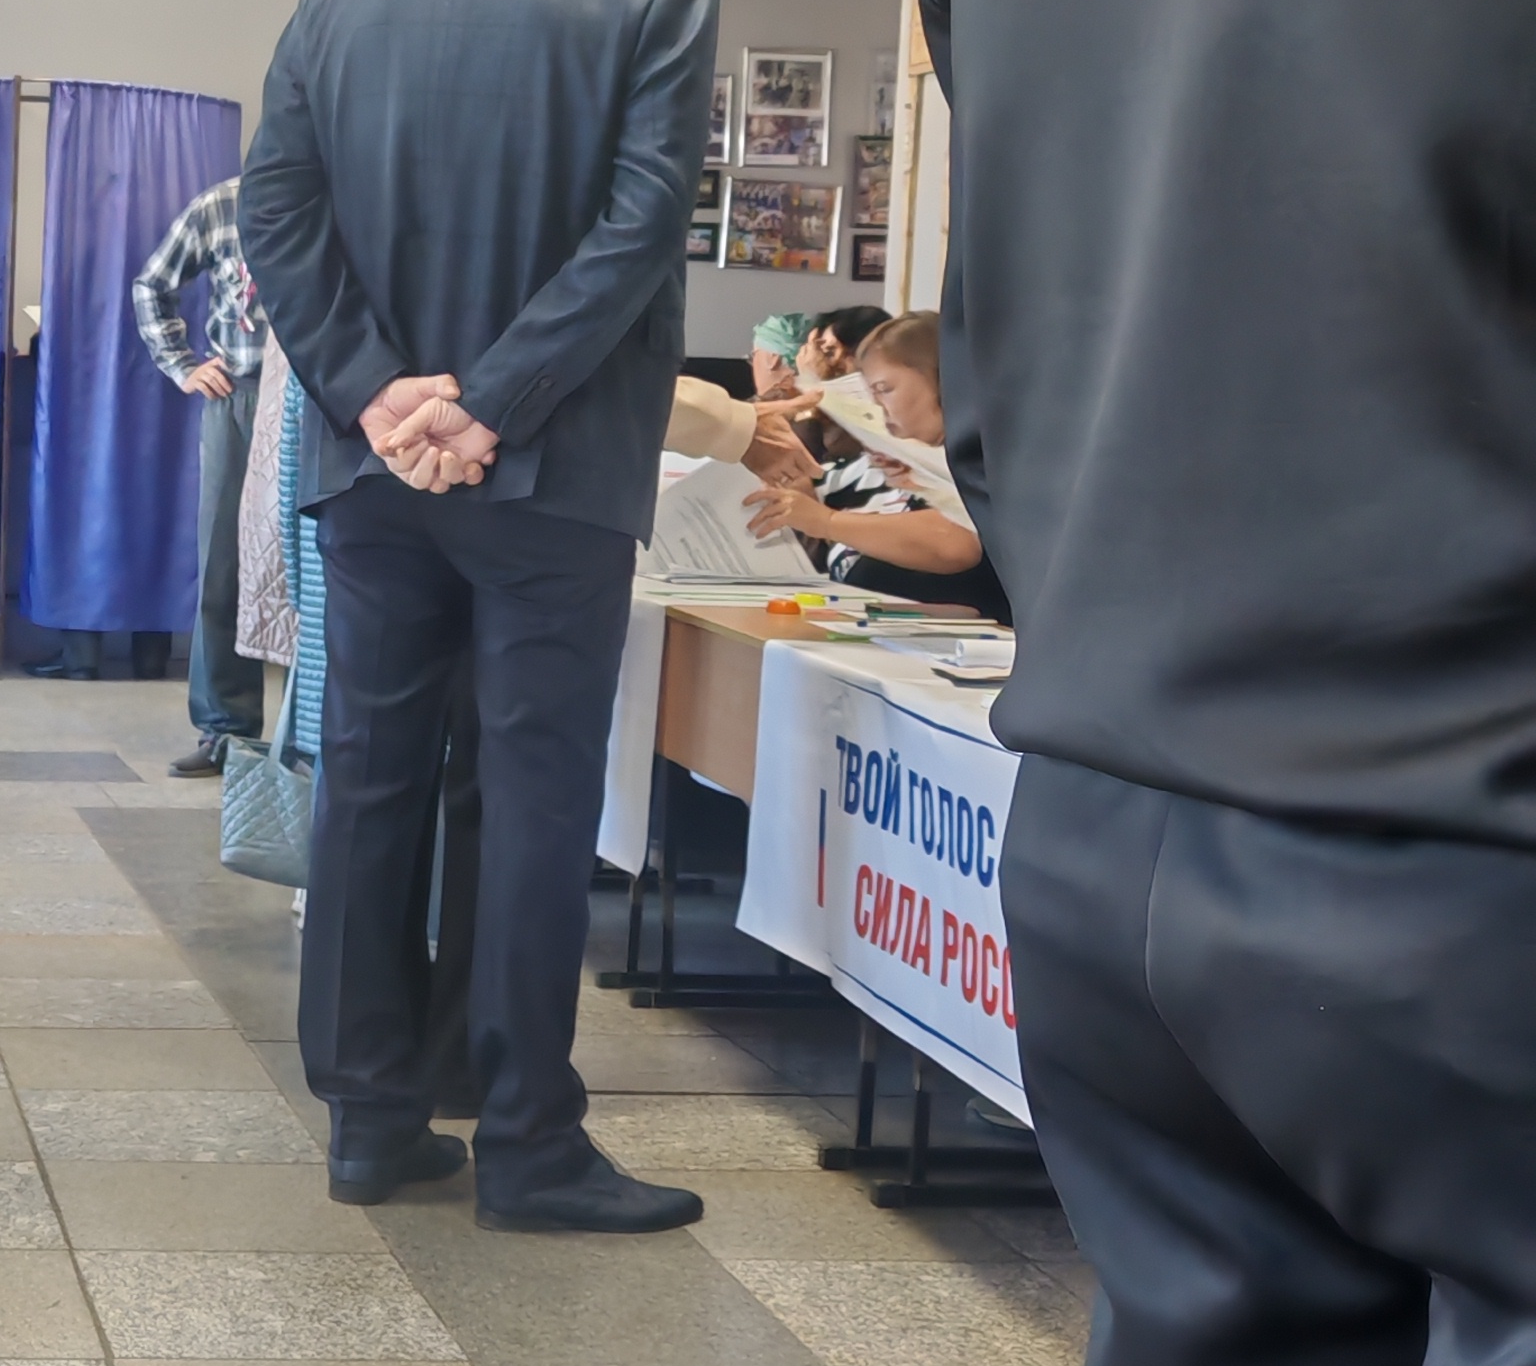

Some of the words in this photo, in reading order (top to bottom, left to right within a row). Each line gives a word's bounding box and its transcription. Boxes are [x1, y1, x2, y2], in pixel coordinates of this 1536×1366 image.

[835, 734, 902, 837] ТВОЙ
[907, 768, 996, 888] ГОЛОС
[853, 863, 931, 977] СИЛА
